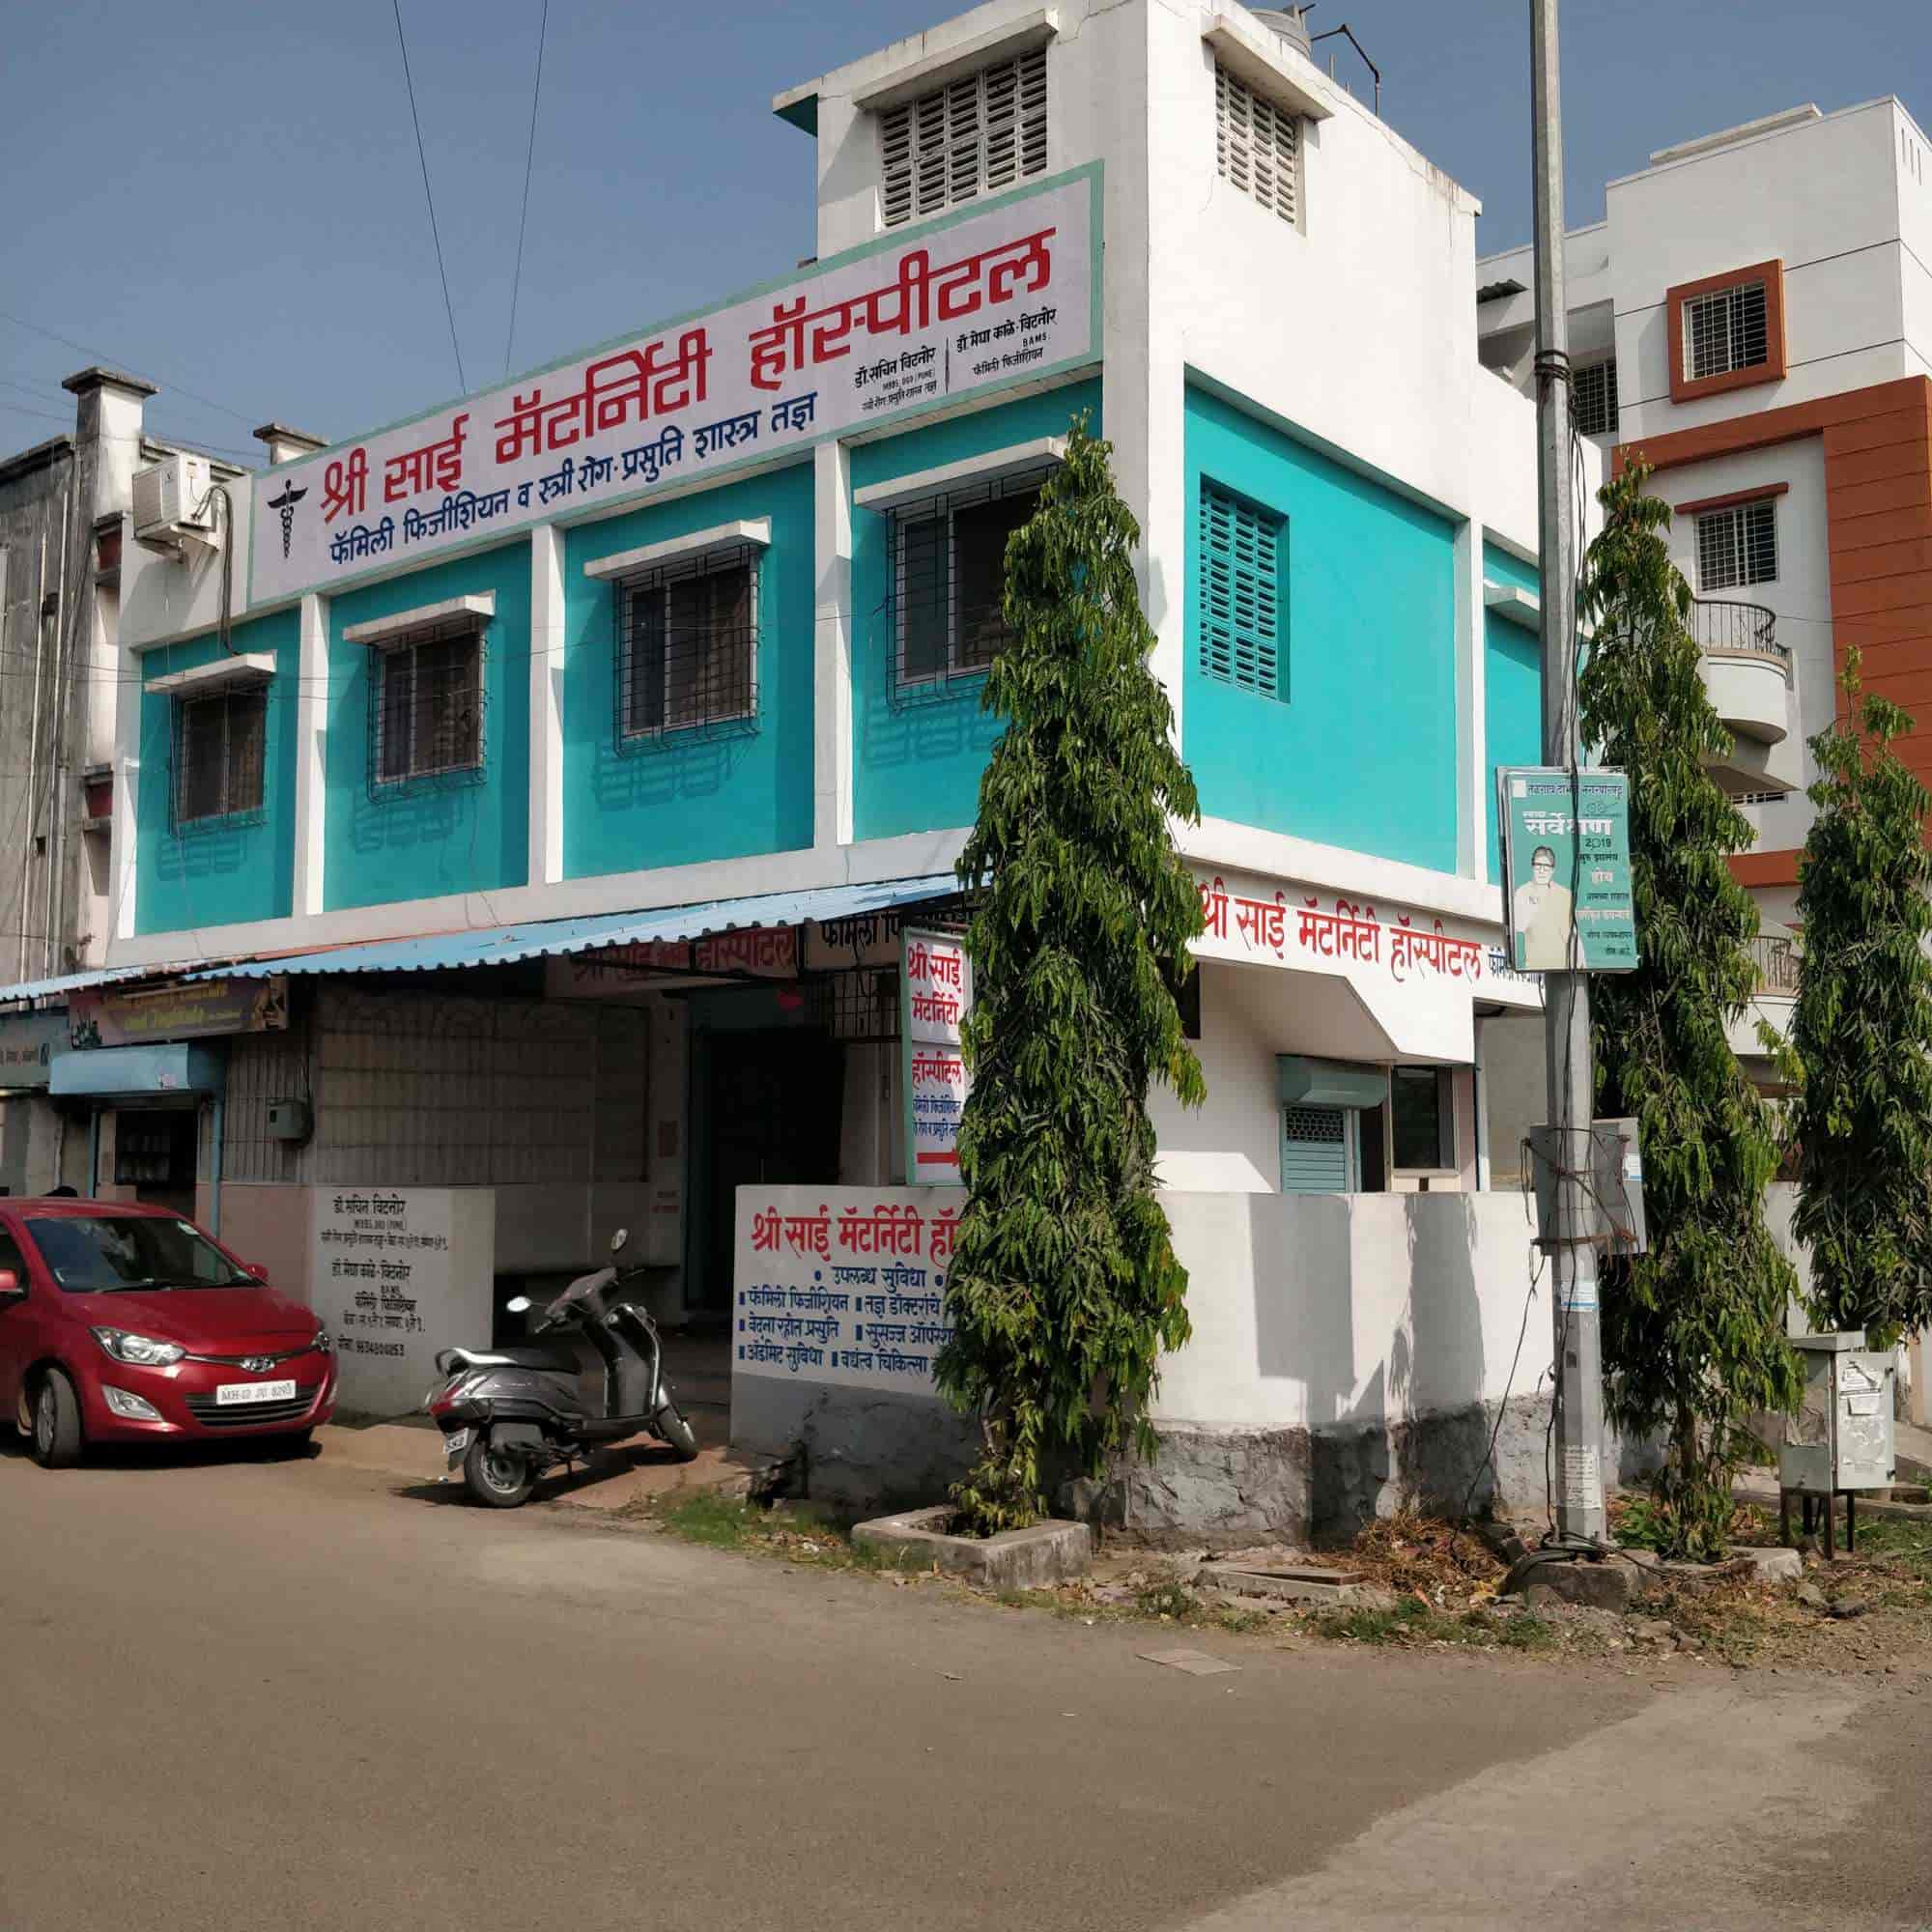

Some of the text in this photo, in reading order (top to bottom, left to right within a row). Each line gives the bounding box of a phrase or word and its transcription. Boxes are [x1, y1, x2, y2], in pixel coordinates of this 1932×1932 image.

[320, 447, 369, 525] श्री
[384, 413, 469, 503] साई
[749, 227, 1057, 391] हॉस्पीटल
[518, 481, 534, 509] व
[1236, 891, 1286, 959] साई
[1389, 912, 1482, 983] हॉस्पीटल
[929, 948, 962, 993] साई
[751, 1206, 782, 1252] श्री
[784, 1204, 832, 1262] साई
